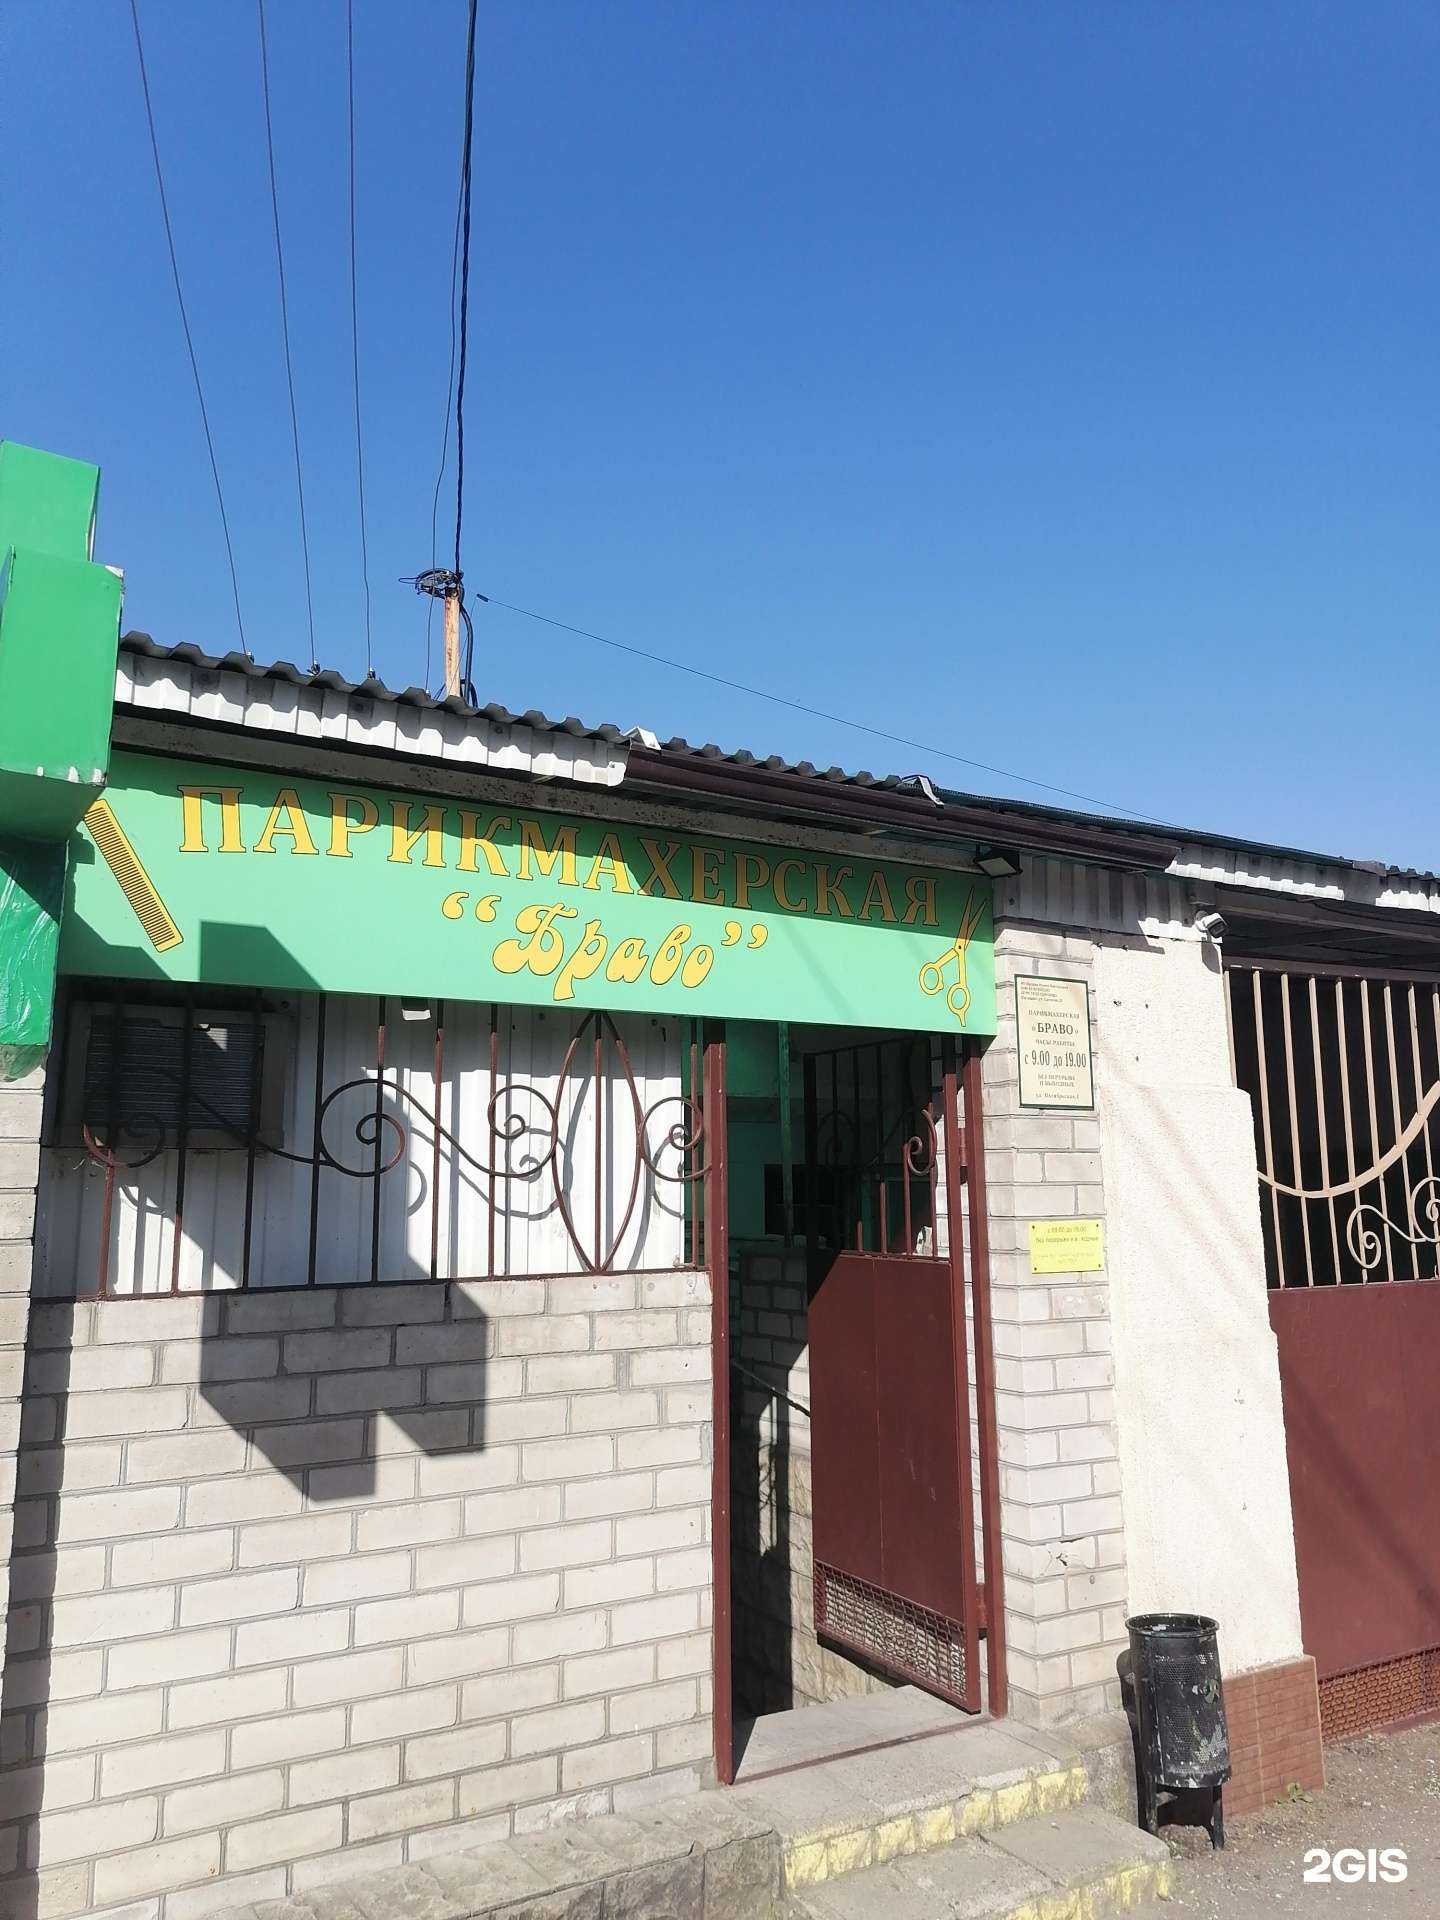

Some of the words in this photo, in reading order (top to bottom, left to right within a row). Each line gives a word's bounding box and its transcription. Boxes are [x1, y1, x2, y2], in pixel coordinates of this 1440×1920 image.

[177, 785, 938, 927] ПАРИКМАХЕРСКАЯ
[1032, 1050, 1050, 1066] 9.00
[1053, 1056, 1062, 1069] до
[1065, 1052, 1087, 1068] 19.00
